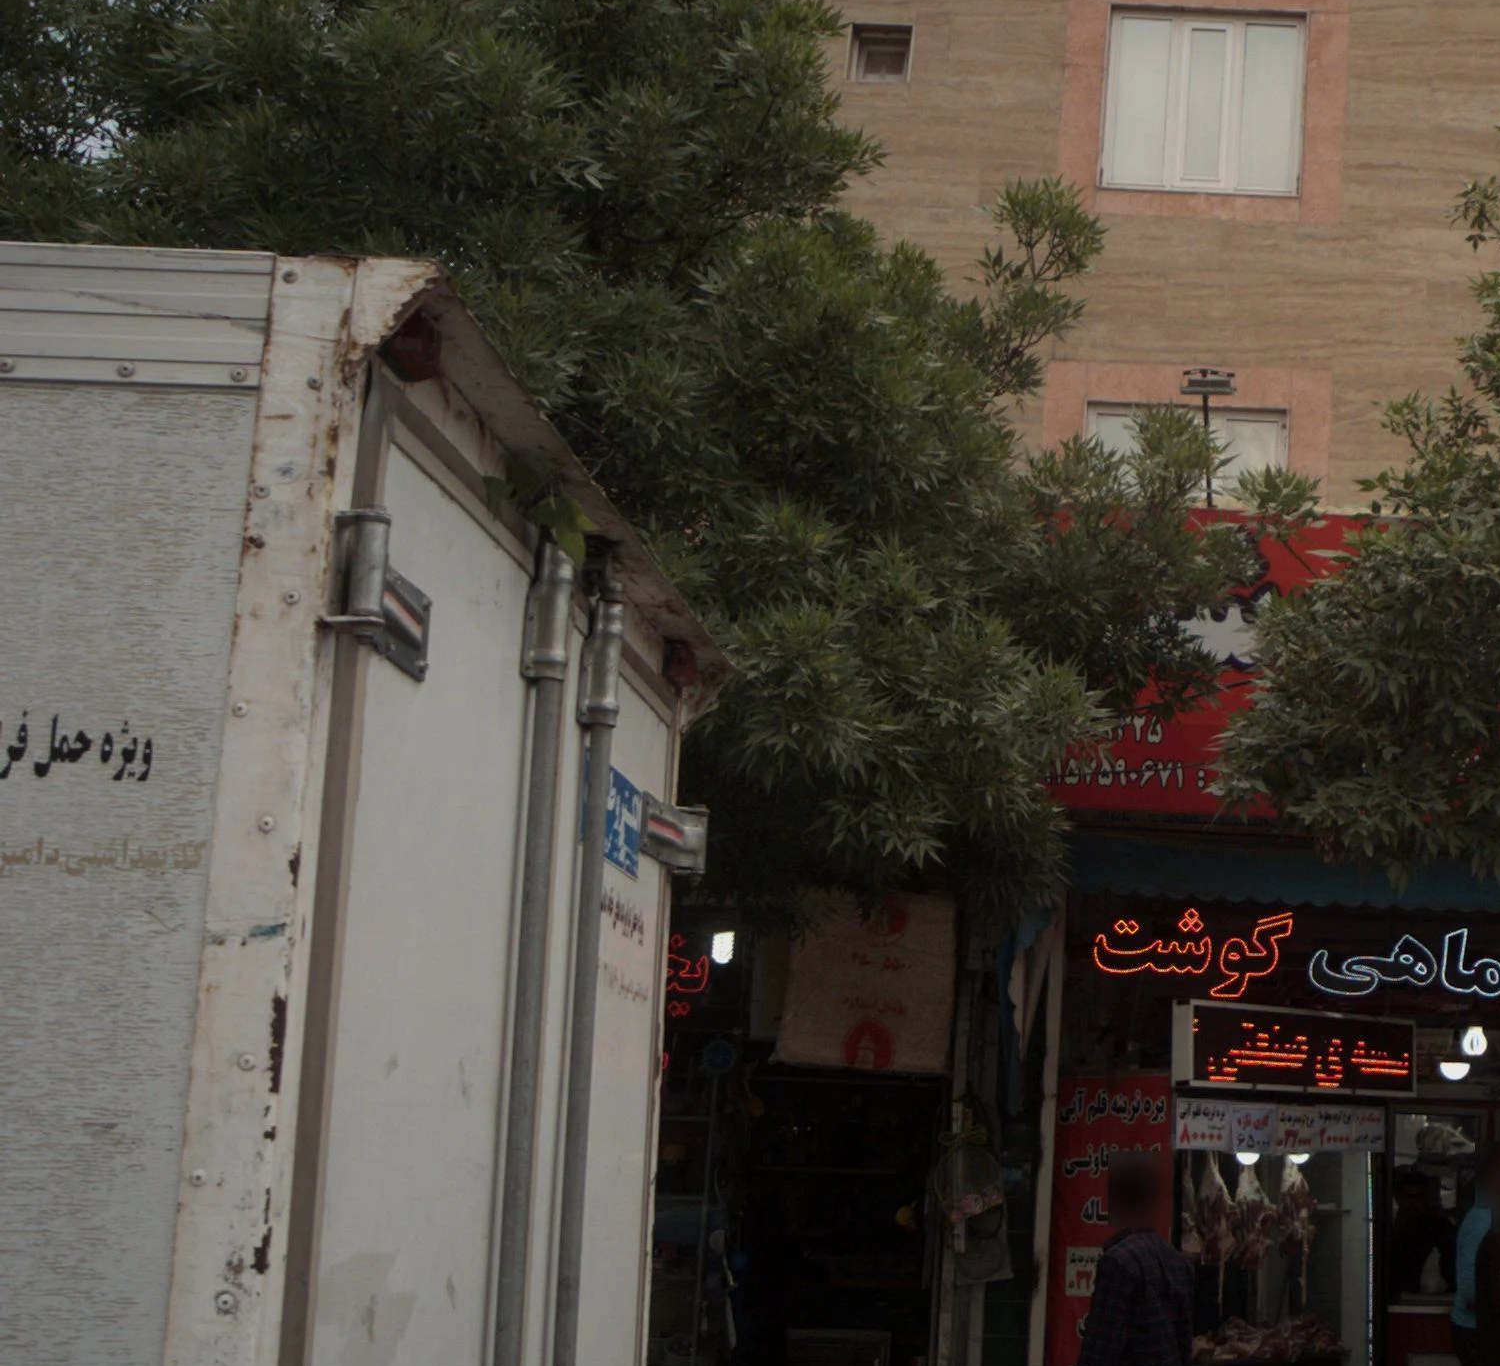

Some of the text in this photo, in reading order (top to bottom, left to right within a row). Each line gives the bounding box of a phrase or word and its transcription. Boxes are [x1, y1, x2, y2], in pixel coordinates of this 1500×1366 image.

[33, 712, 93, 778] حمل
[99, 719, 153, 782] ویژه
[1092, 908, 1294, 1000] گوشت
[1059, 1087, 1086, 1124] آبی
[1087, 1089, 1110, 1124] قلم
[1143, 1095, 1166, 1124] بره
